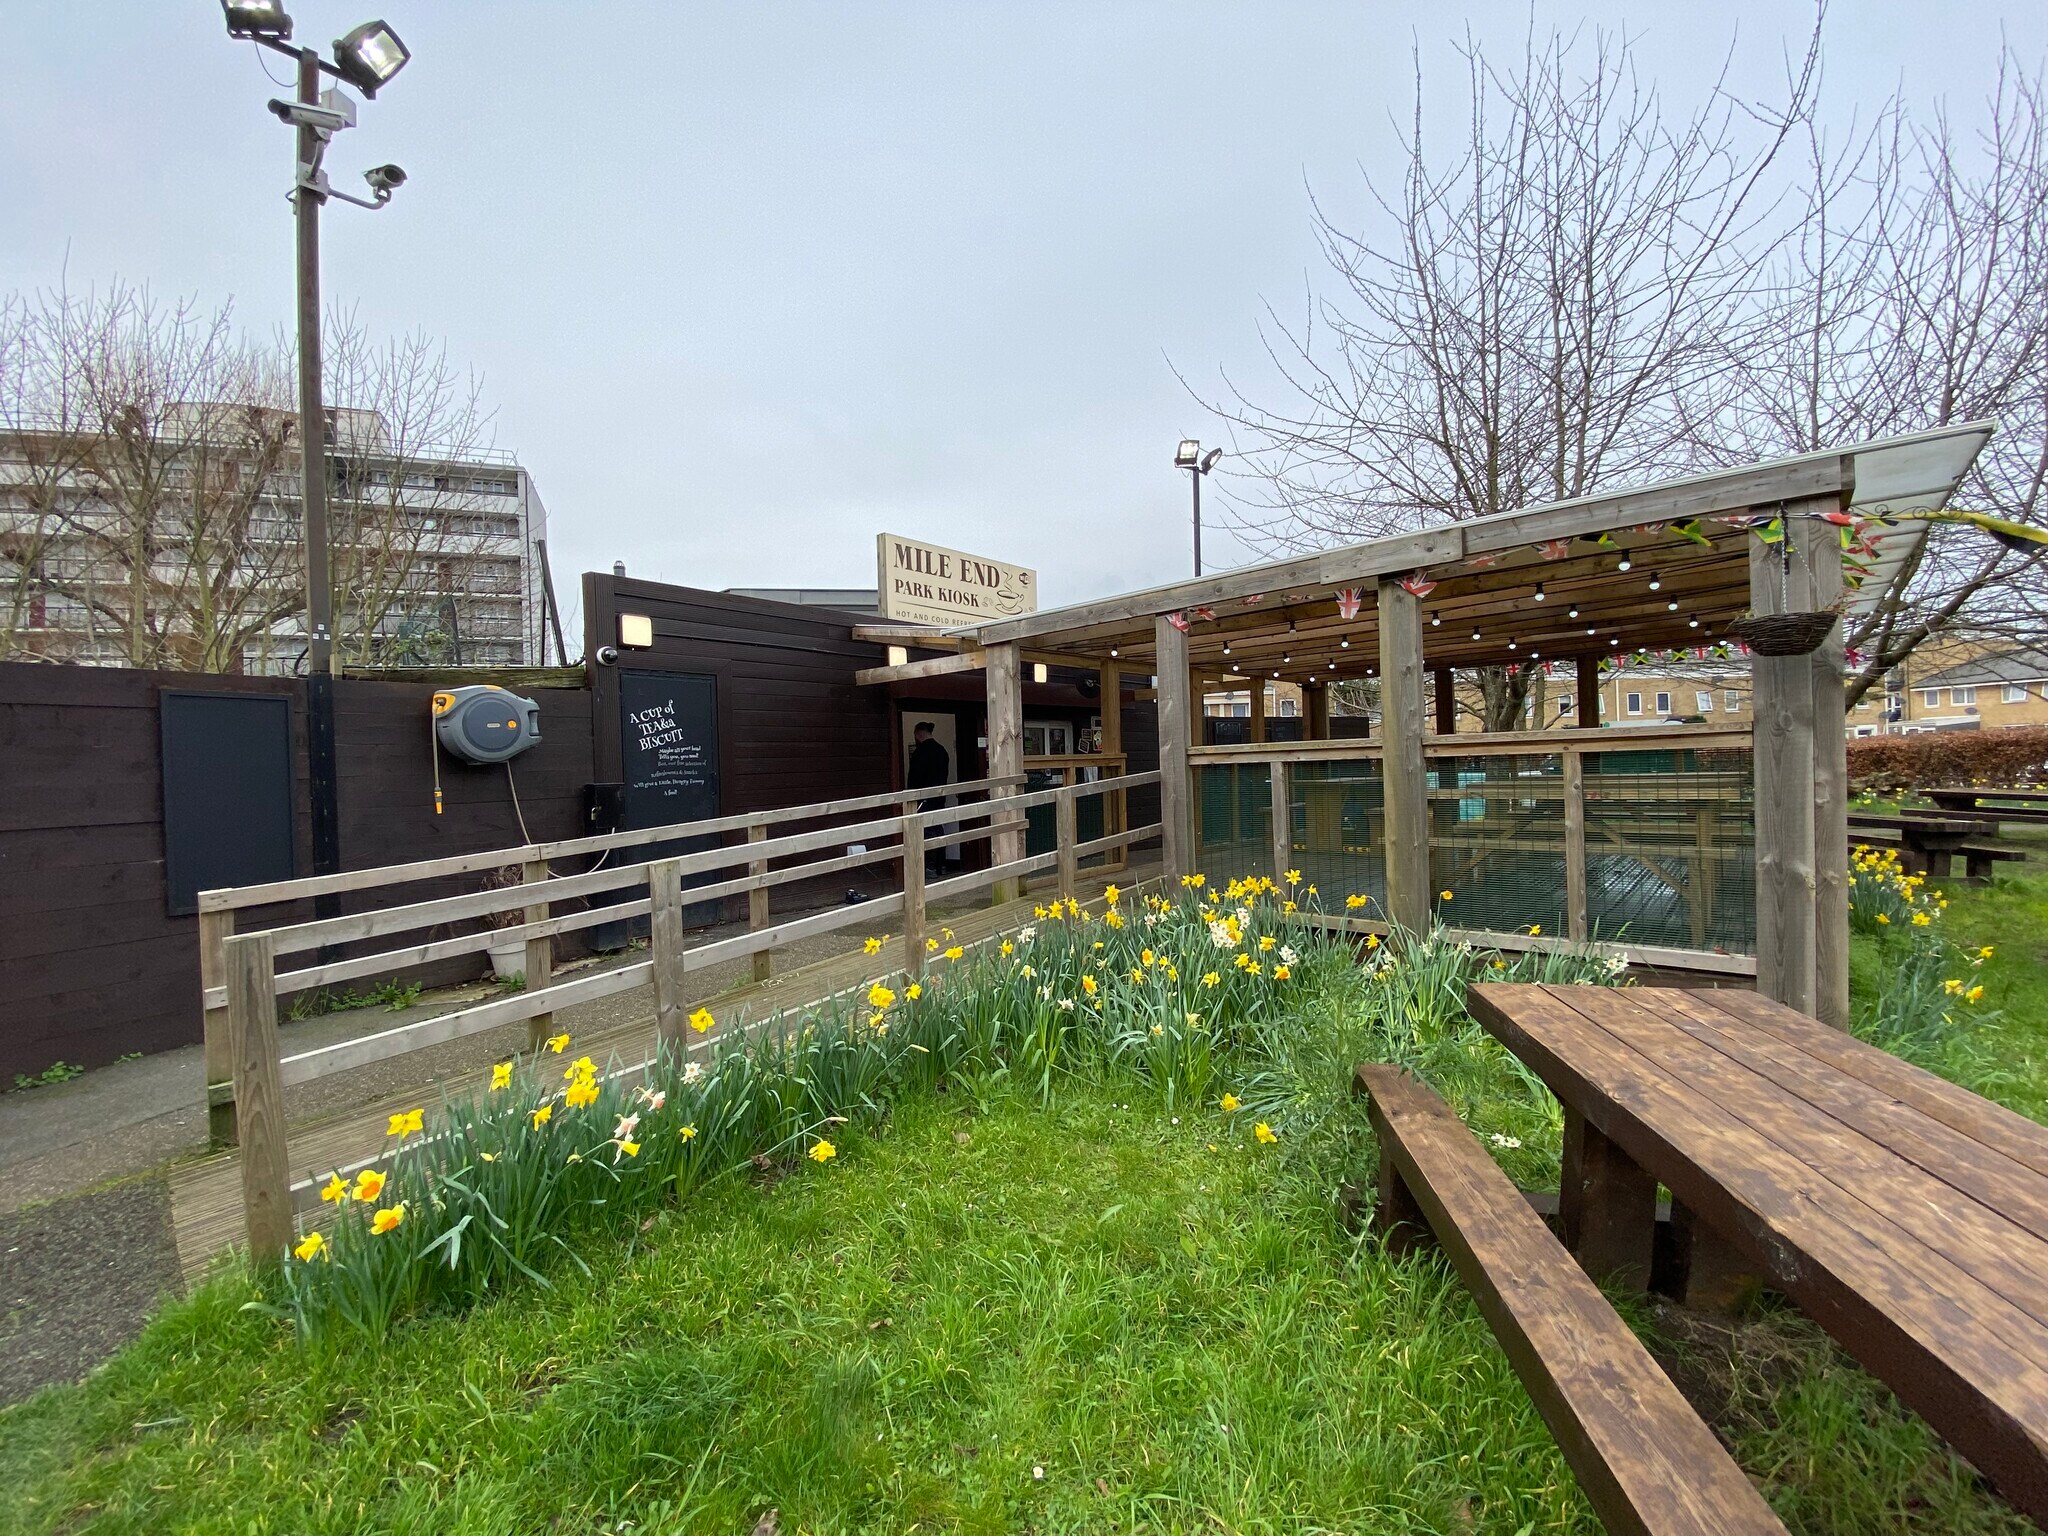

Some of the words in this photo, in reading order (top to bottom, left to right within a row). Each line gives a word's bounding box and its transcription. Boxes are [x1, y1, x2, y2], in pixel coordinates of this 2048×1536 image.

[894, 542, 953, 579] MILE
[960, 558, 1000, 588] END
[894, 578, 934, 600] PARK
[938, 587, 980, 608] KIOSK
[896, 610, 910, 618] HOT
[913, 613, 929, 621] AND
[931, 615, 949, 624] COLD
[629, 712, 640, 724] A
[640, 706, 663, 721] CUP
[664, 698, 675, 715] of
[638, 728, 684, 751] BISCUIT
